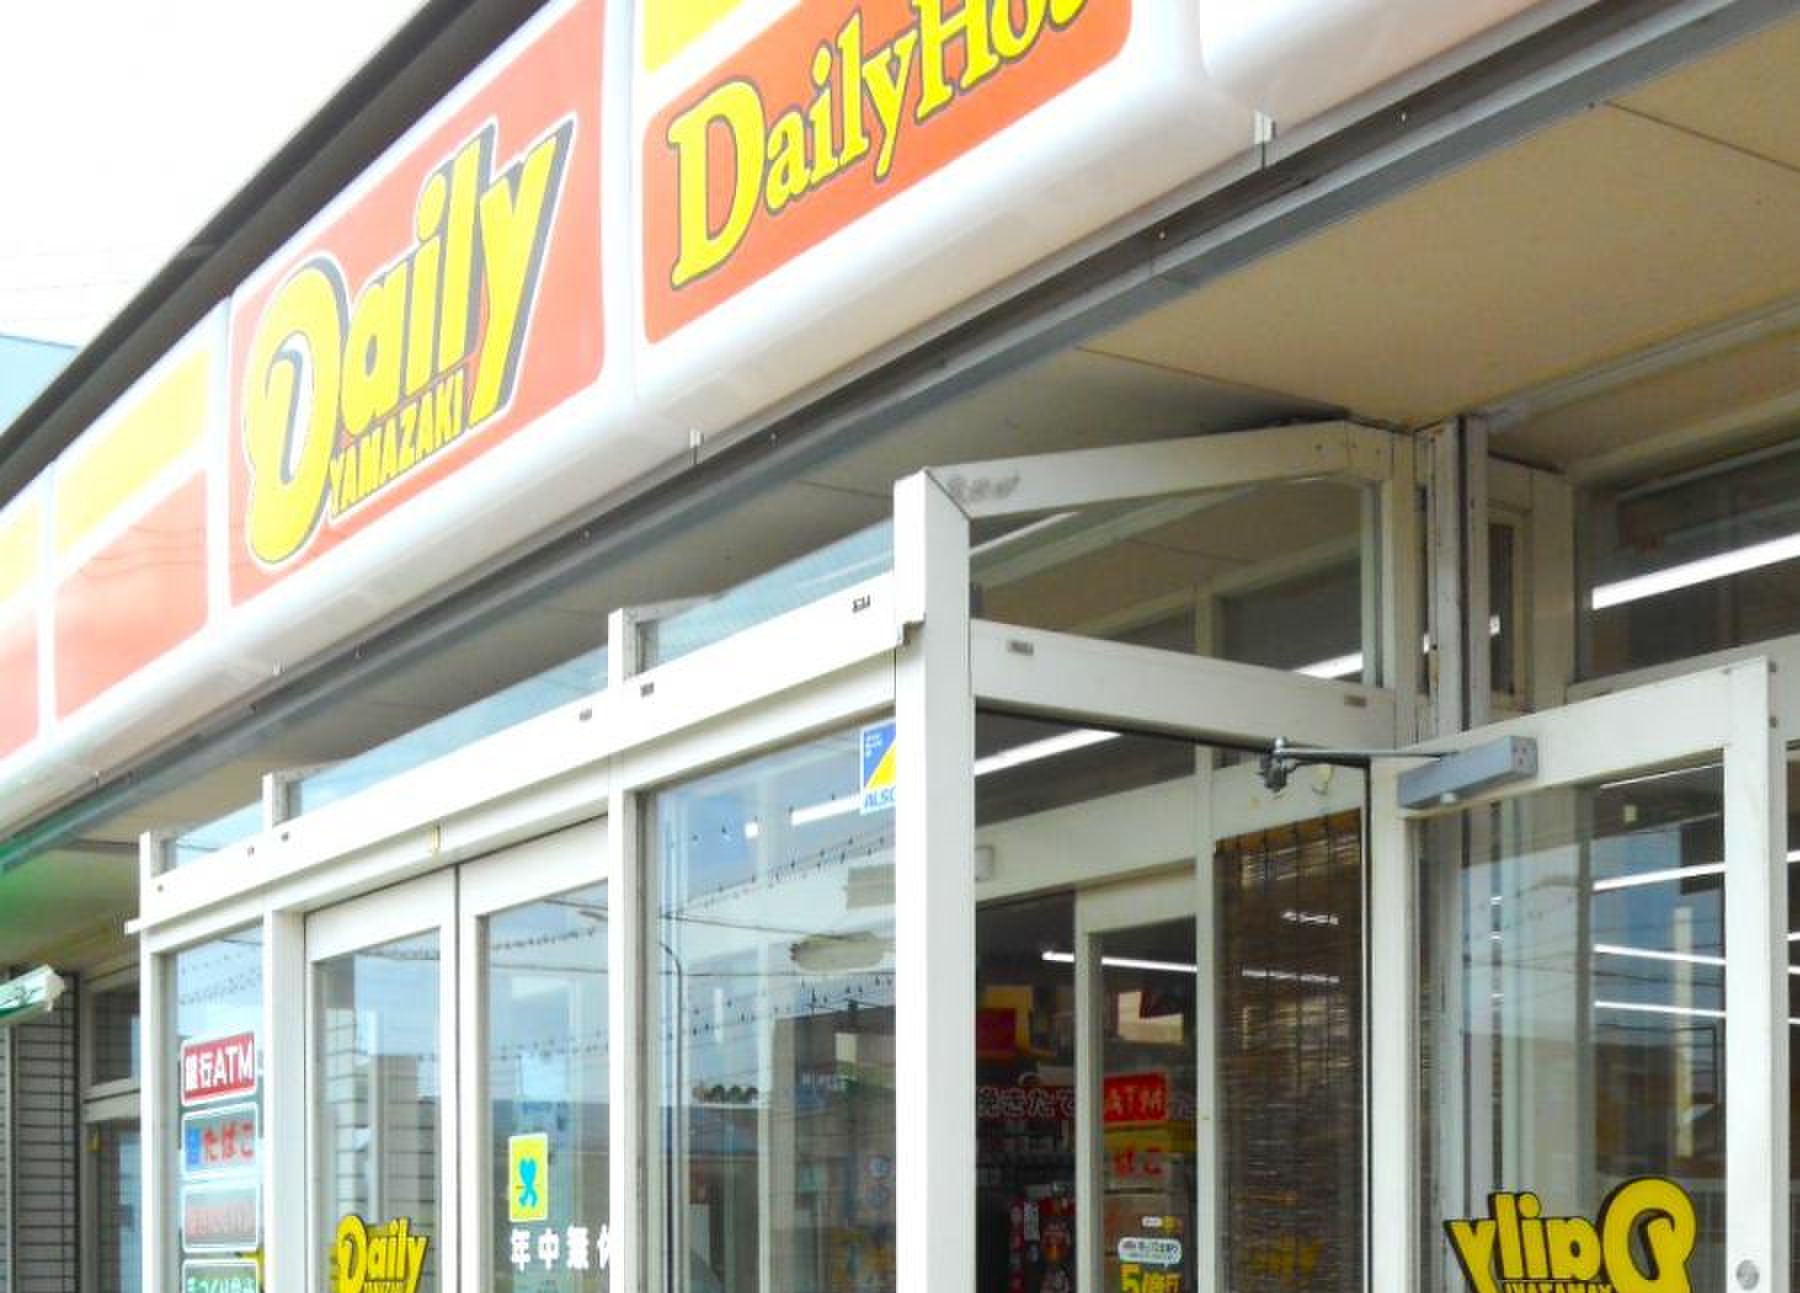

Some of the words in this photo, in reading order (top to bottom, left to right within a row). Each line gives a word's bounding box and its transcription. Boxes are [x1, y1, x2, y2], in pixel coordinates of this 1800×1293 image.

[667, 0, 1089, 289] DailyHo
[245, 118, 574, 563] Daily
[327, 367, 467, 518] YAMAZAKI
